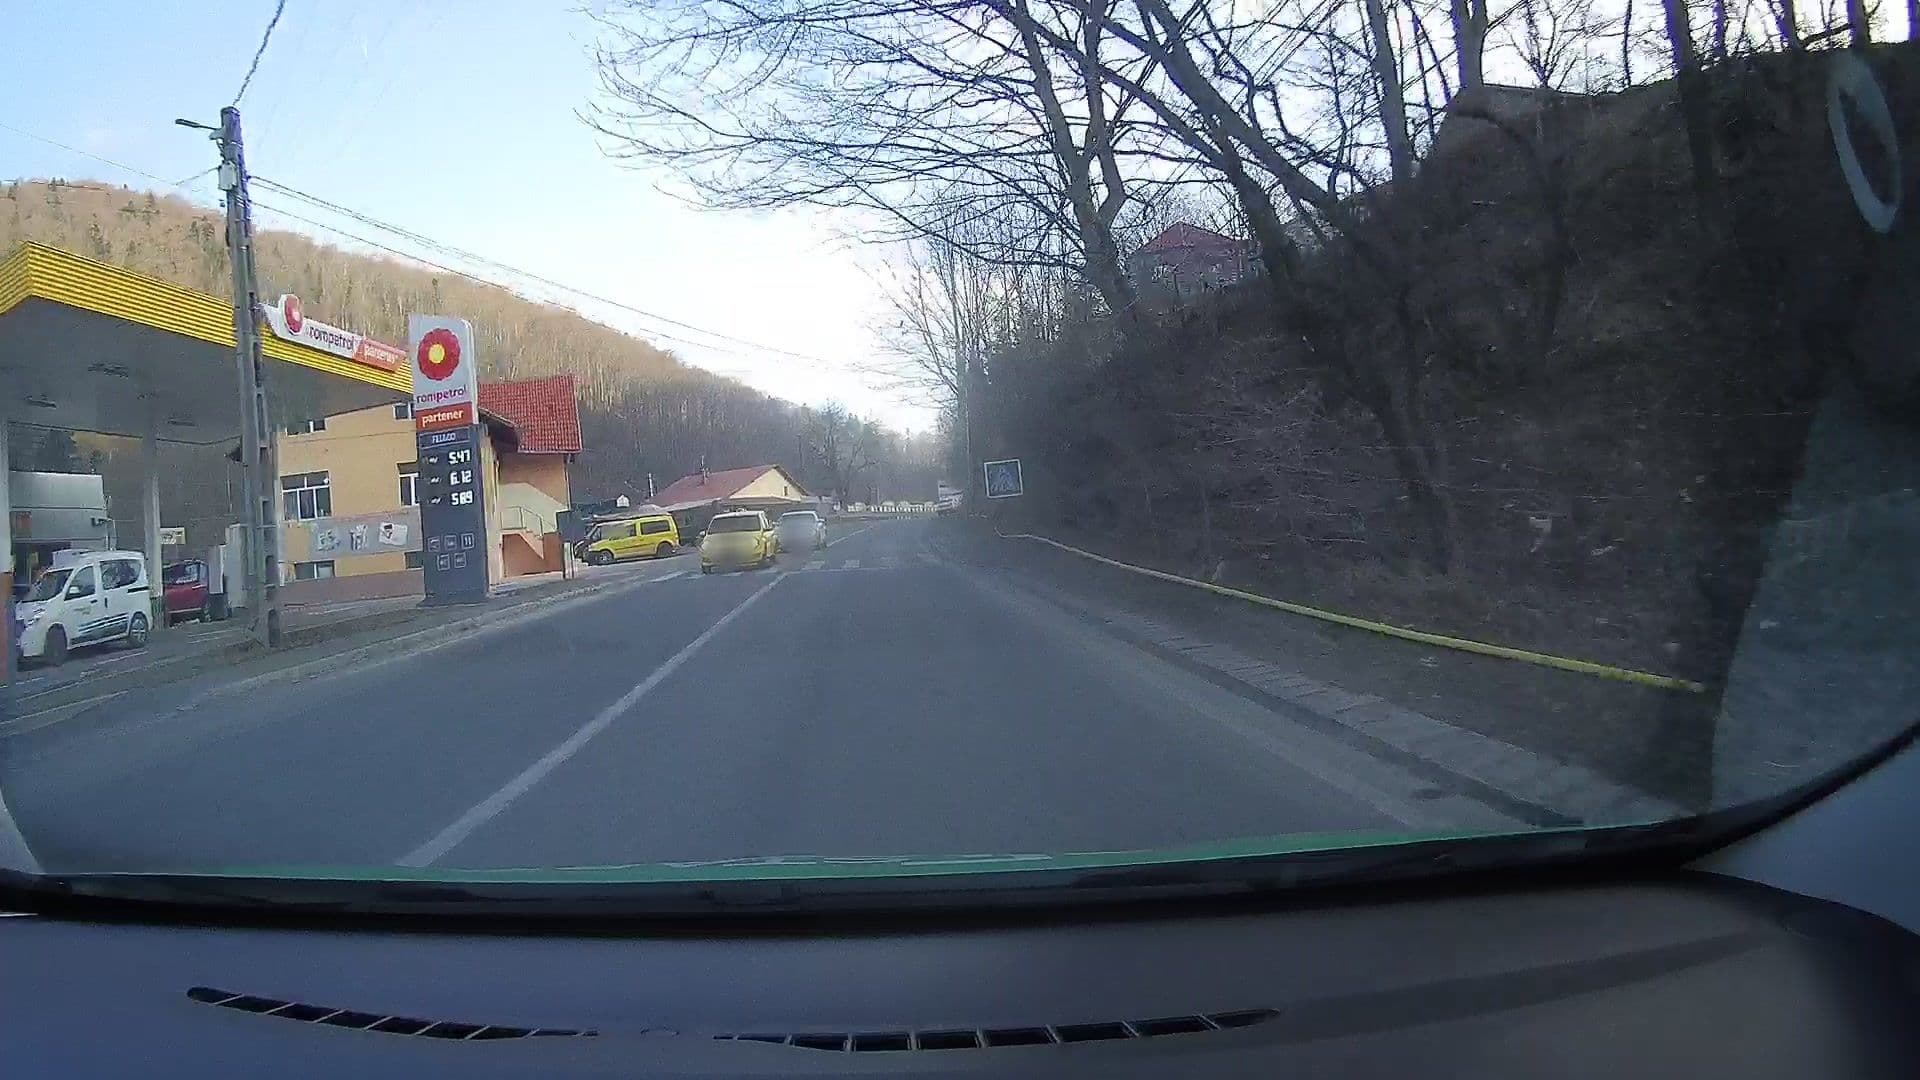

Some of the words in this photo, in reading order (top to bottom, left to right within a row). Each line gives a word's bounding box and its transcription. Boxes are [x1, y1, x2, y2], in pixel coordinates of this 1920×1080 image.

[308, 325, 354, 350] rompetrol
[416, 385, 467, 403] rompetrol
[422, 410, 464, 427] partener
[448, 449, 471, 465] 5.47
